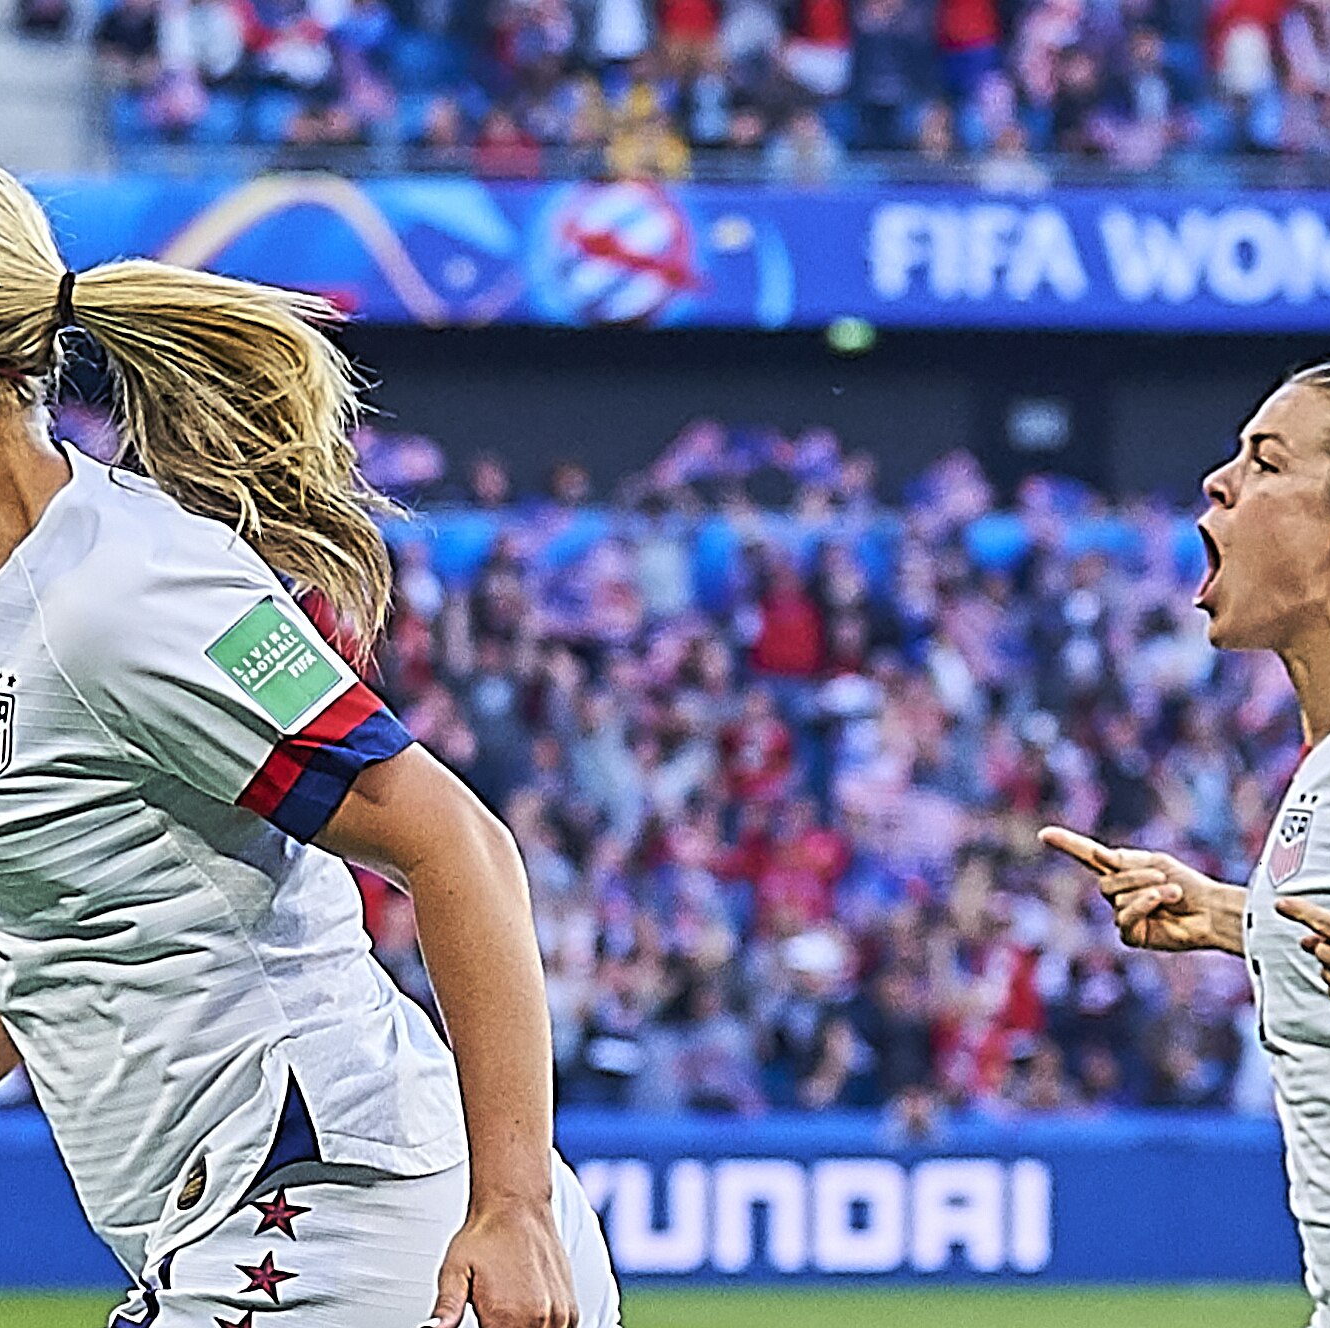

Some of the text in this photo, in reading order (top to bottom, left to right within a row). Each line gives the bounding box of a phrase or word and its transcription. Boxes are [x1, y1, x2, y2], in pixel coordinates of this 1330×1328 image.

[872, 203, 1087, 300] FIFA
[232, 622, 291, 677] LIVING
[241, 634, 299, 686] FOOTBALL
[287, 648, 318, 679] FIFA
